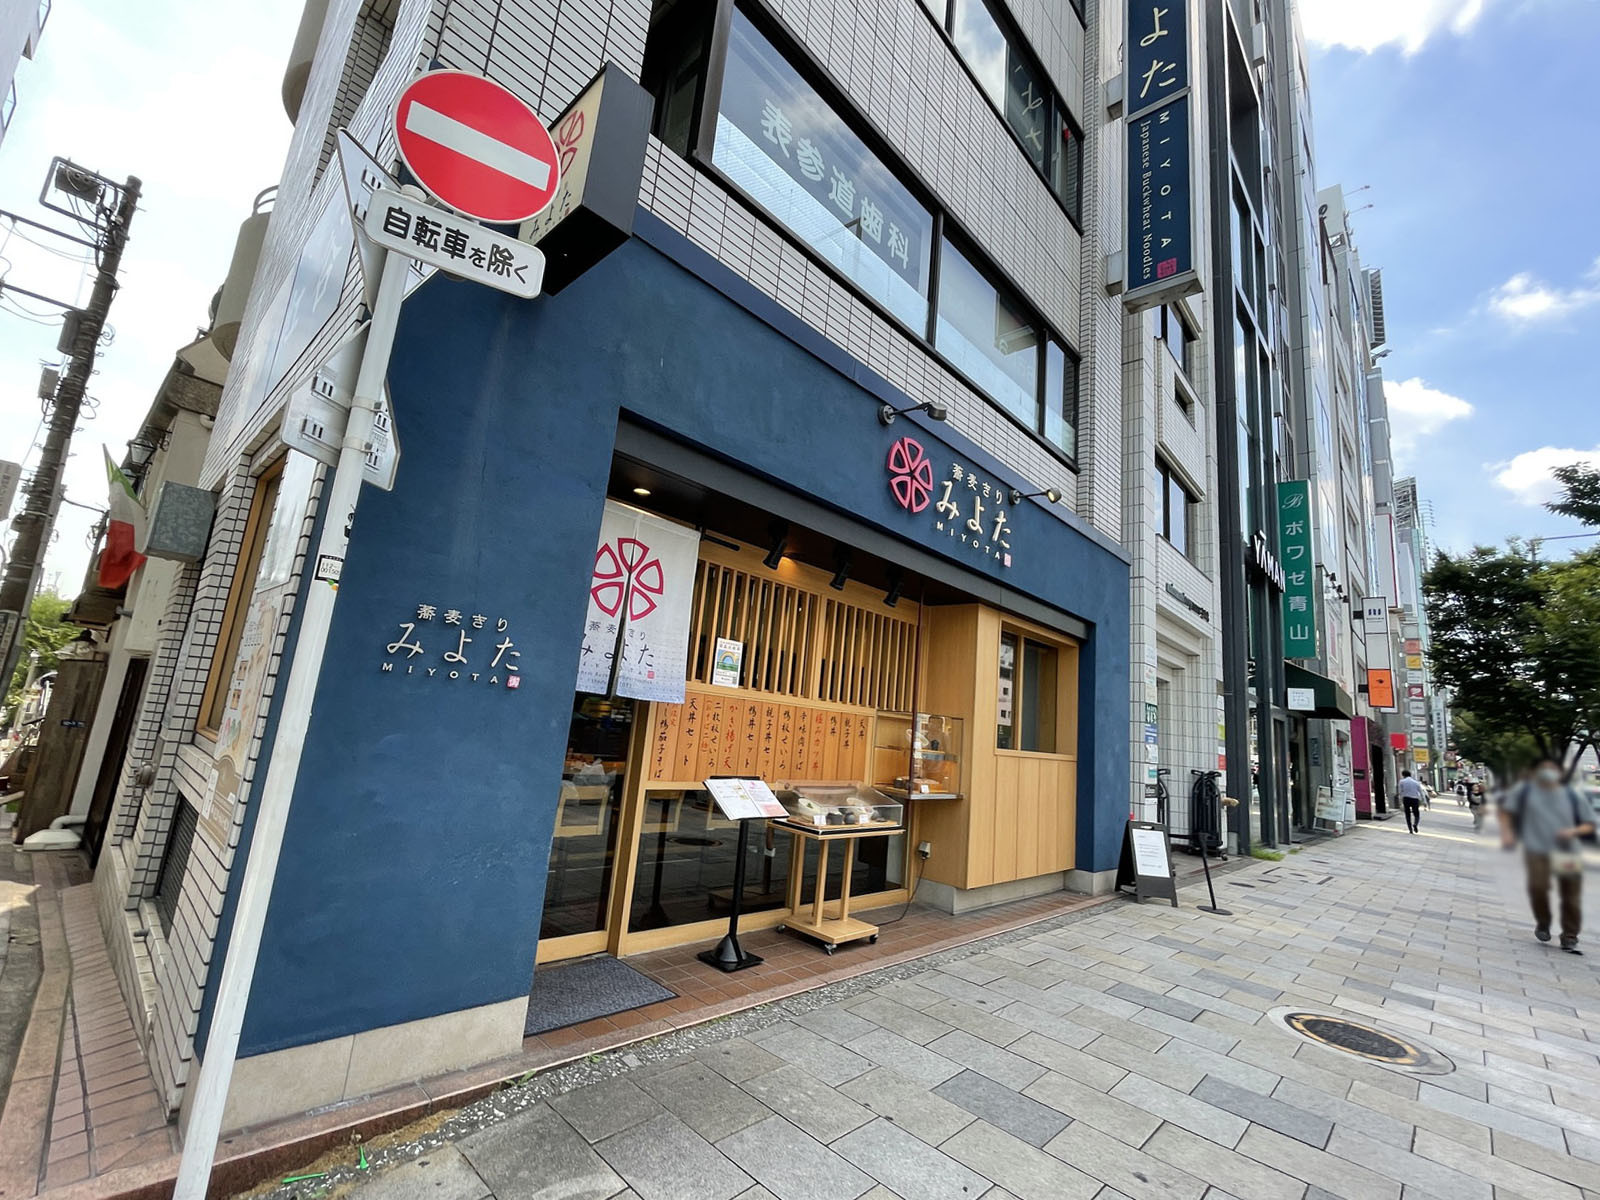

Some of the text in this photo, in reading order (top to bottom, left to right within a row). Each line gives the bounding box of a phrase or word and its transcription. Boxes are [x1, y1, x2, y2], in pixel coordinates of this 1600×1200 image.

[1140, 7, 1177, 98] よた
[761, 98, 909, 270] 表参道歯科
[1140, 120, 1153, 280] Japanese Buckwheat Noodles
[1159, 110, 1172, 249] MIYOTA
[383, 206, 529, 285] 自転車を除く
[936, 480, 1011, 549] みよた
[952, 462, 1003, 505] 蕎麦きり
[937, 521, 1001, 560] MIYOTA
[1285, 519, 1309, 641] ボワゼ青山
[386, 622, 521, 671] みよた
[417, 603, 509, 632] 蕎麦きり
[381, 662, 499, 684] MIYOTA
